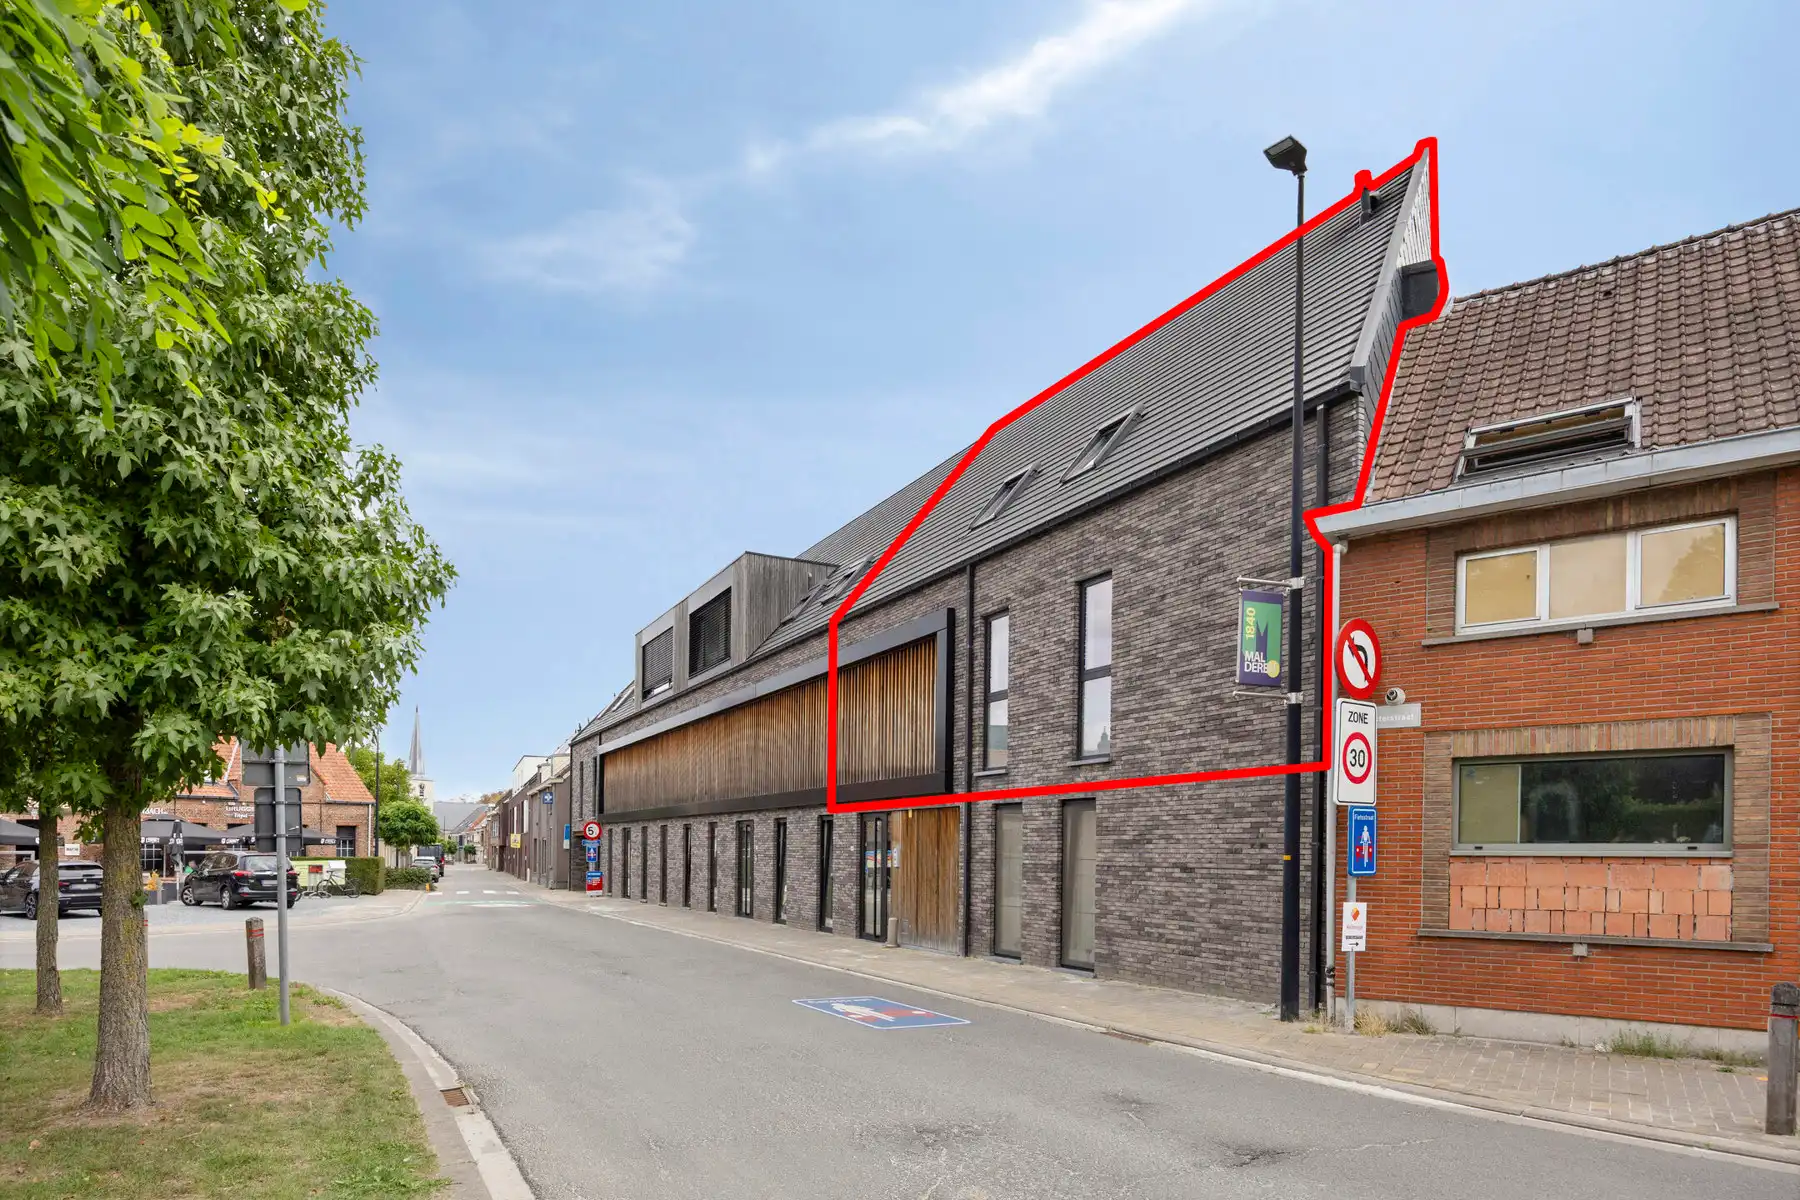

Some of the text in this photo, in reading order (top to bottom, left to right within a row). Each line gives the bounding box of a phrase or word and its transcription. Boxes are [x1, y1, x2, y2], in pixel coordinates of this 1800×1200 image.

[1246, 607, 1256, 640] 1840
[1244, 650, 1266, 663] MAL
[1348, 711, 1369, 724] ZONE
[1349, 749, 1366, 767] 30
